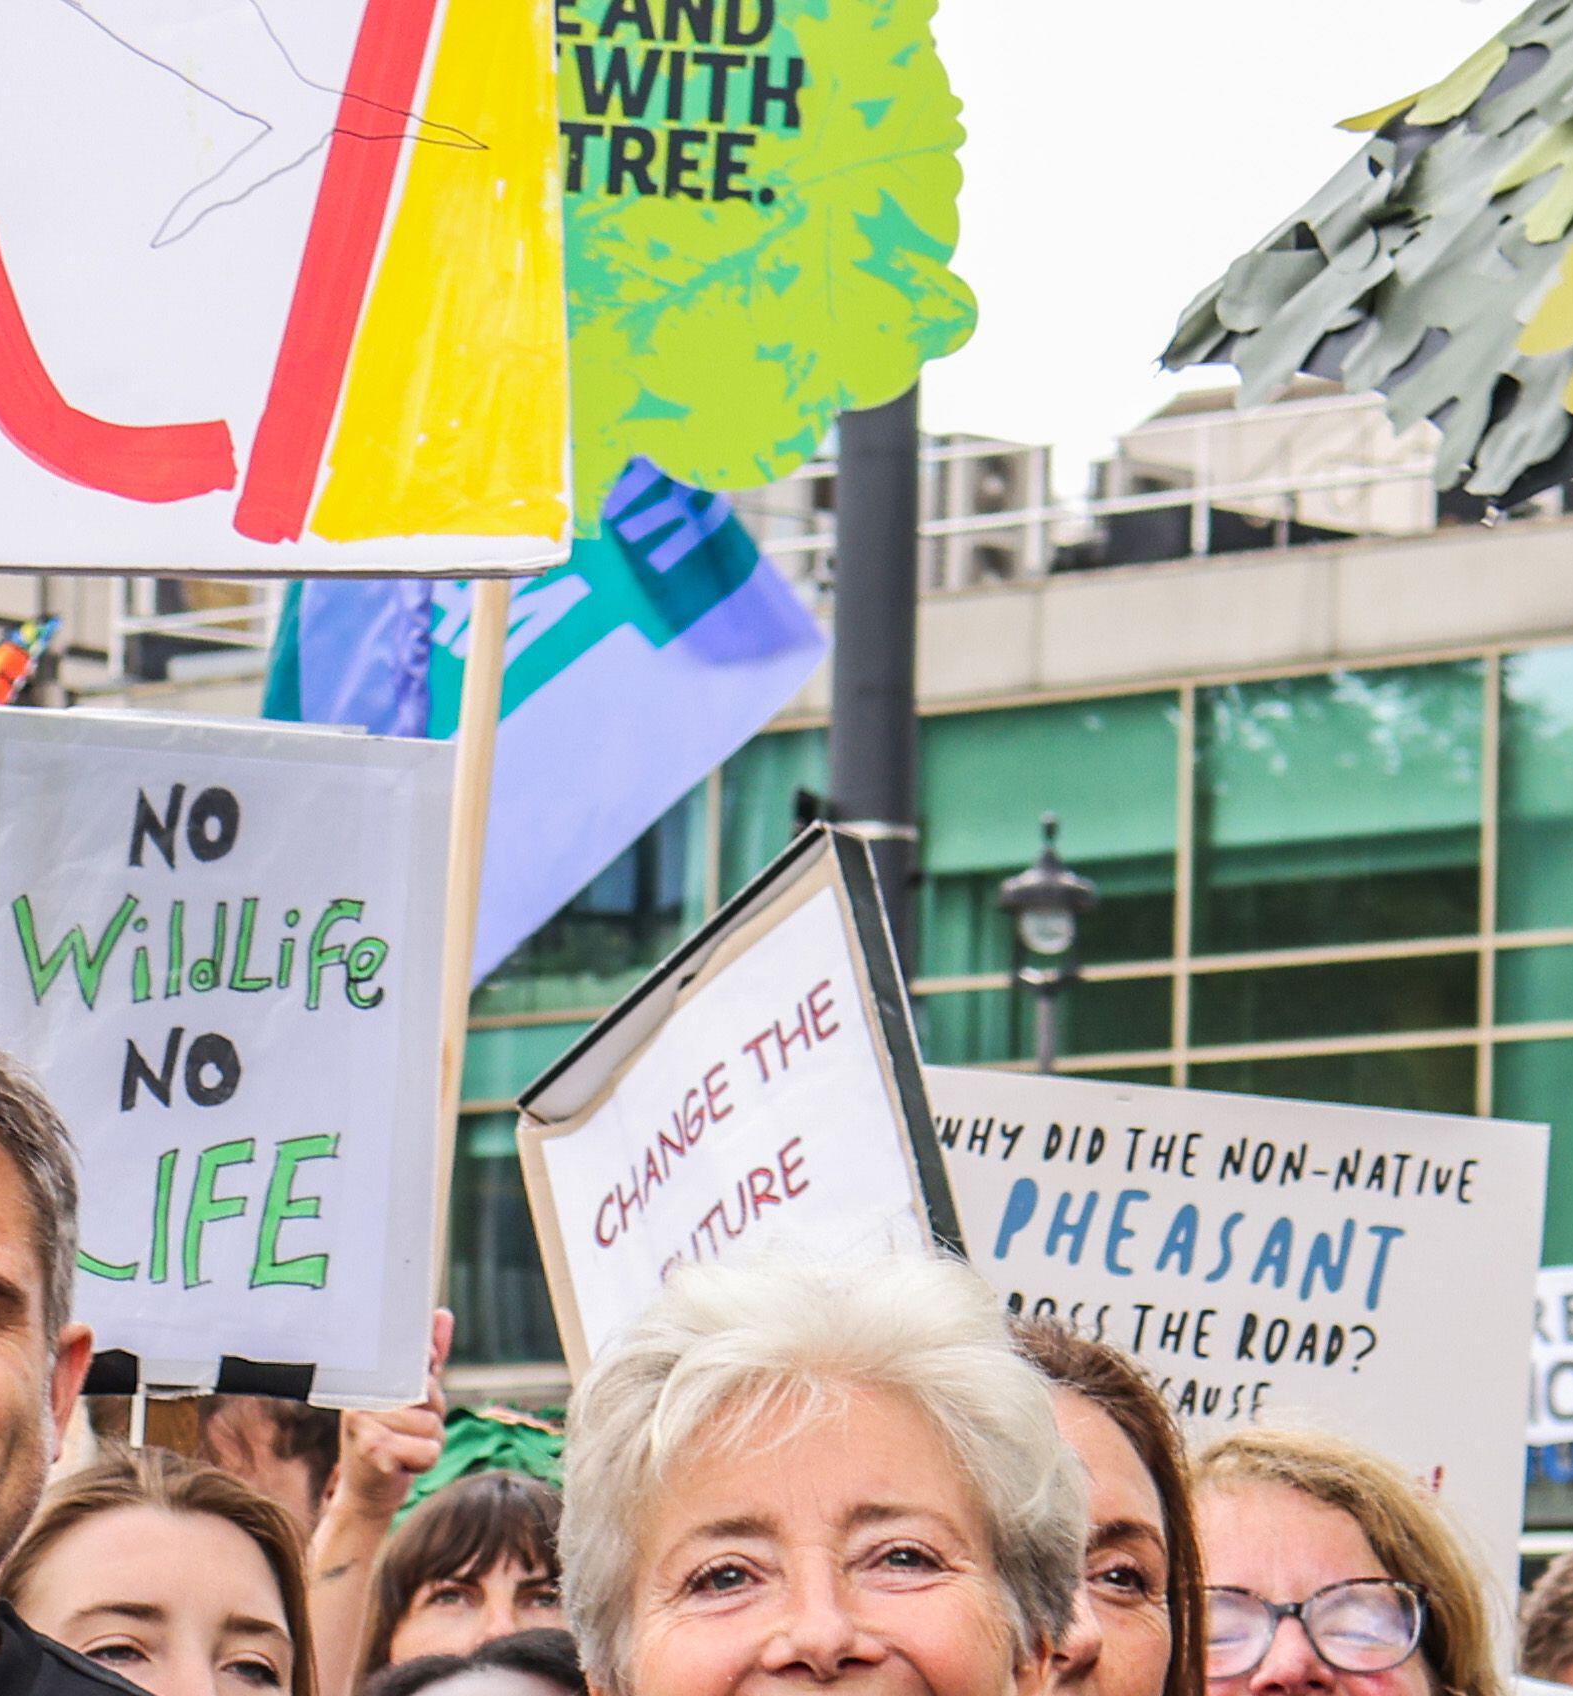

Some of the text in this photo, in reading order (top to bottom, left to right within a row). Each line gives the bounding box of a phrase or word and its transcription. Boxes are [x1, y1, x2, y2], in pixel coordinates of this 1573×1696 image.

[575, 44, 805, 129] WITH
[560, 121, 775, 206] TREE.
[128, 782, 241, 870] NO
[120, 1026, 241, 1113] NO
[594, 979, 842, 1249] CHANGE THE
[935, 1115, 1482, 1205] WHY DID THE NON-NATIVE
[993, 1177, 1407, 1312] PHEASANT
[1133, 1303, 1219, 1360] THE
[1236, 1311, 1380, 1375] ROAD?
